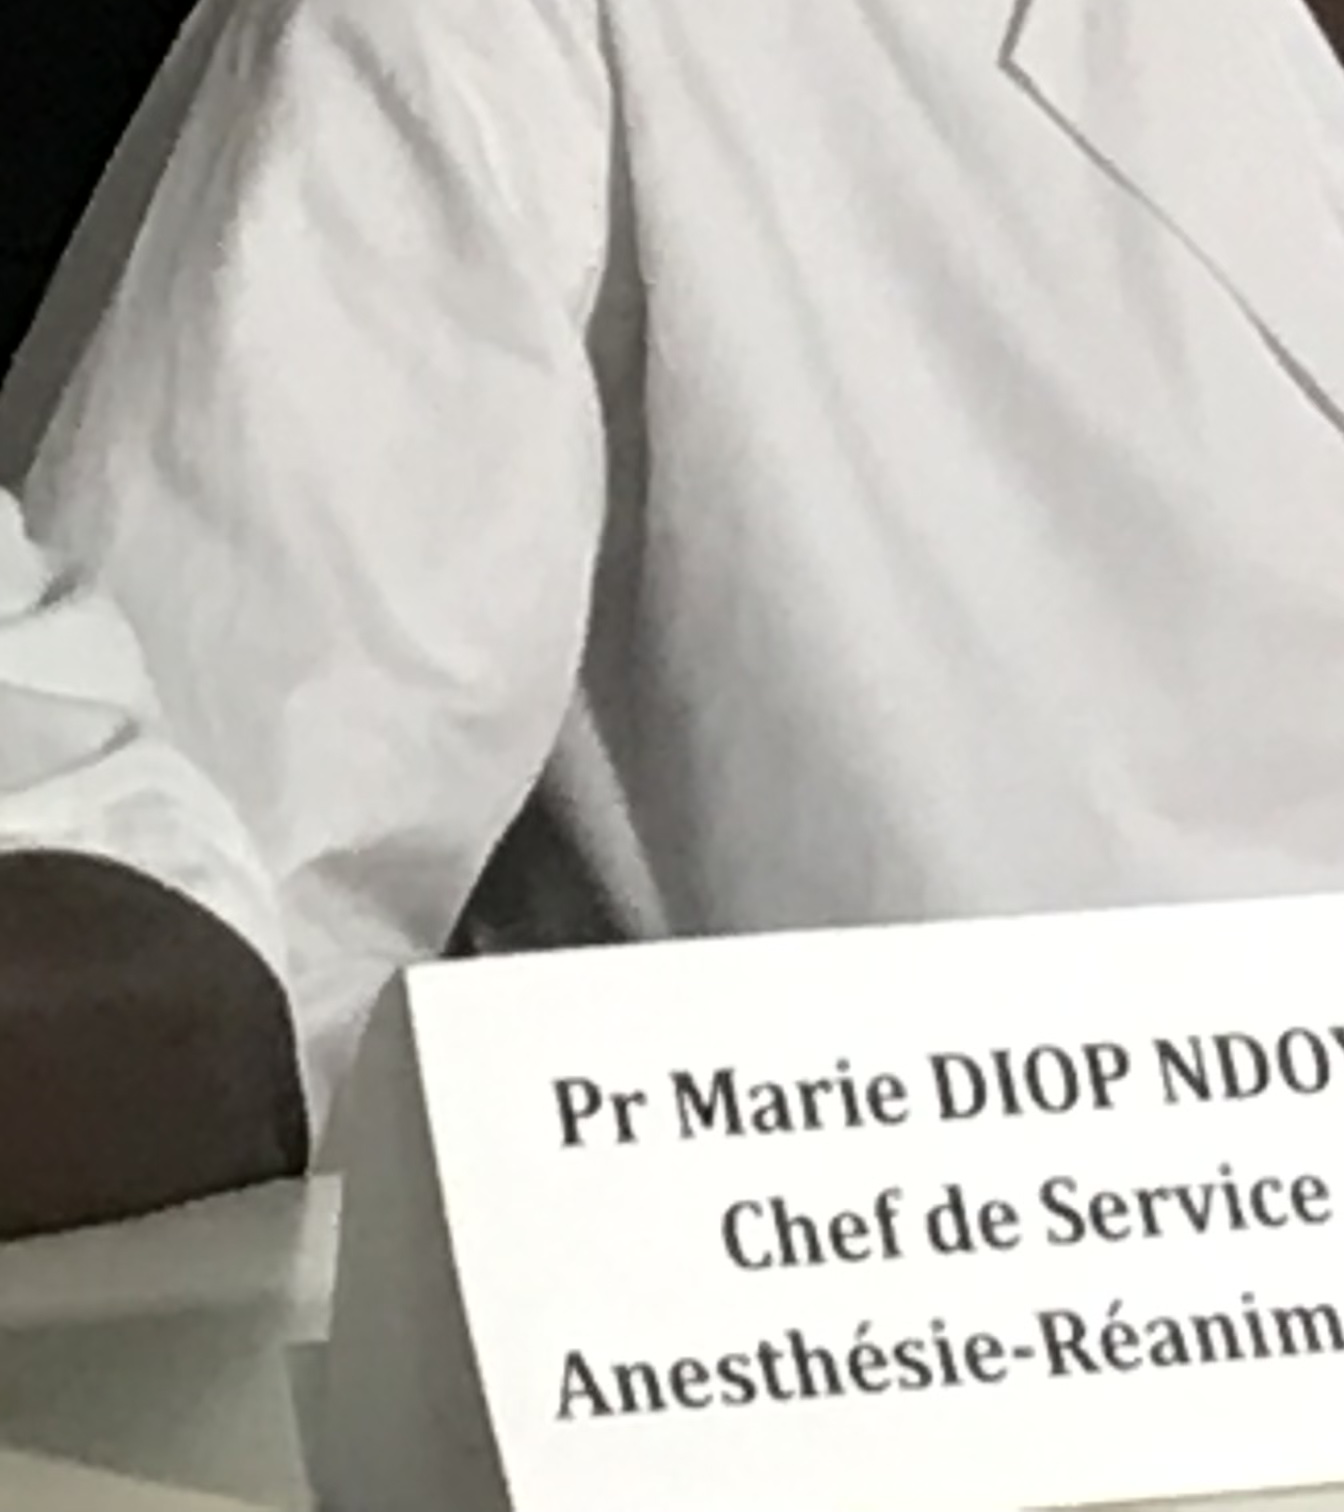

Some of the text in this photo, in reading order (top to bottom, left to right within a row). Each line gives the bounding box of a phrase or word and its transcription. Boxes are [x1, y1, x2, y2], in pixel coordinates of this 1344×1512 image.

[553, 1076, 648, 1148] Pr
[670, 1058, 909, 1140] Marie
[928, 1041, 1132, 1122] DIOP
[720, 1163, 1332, 1271] Chef de Service
